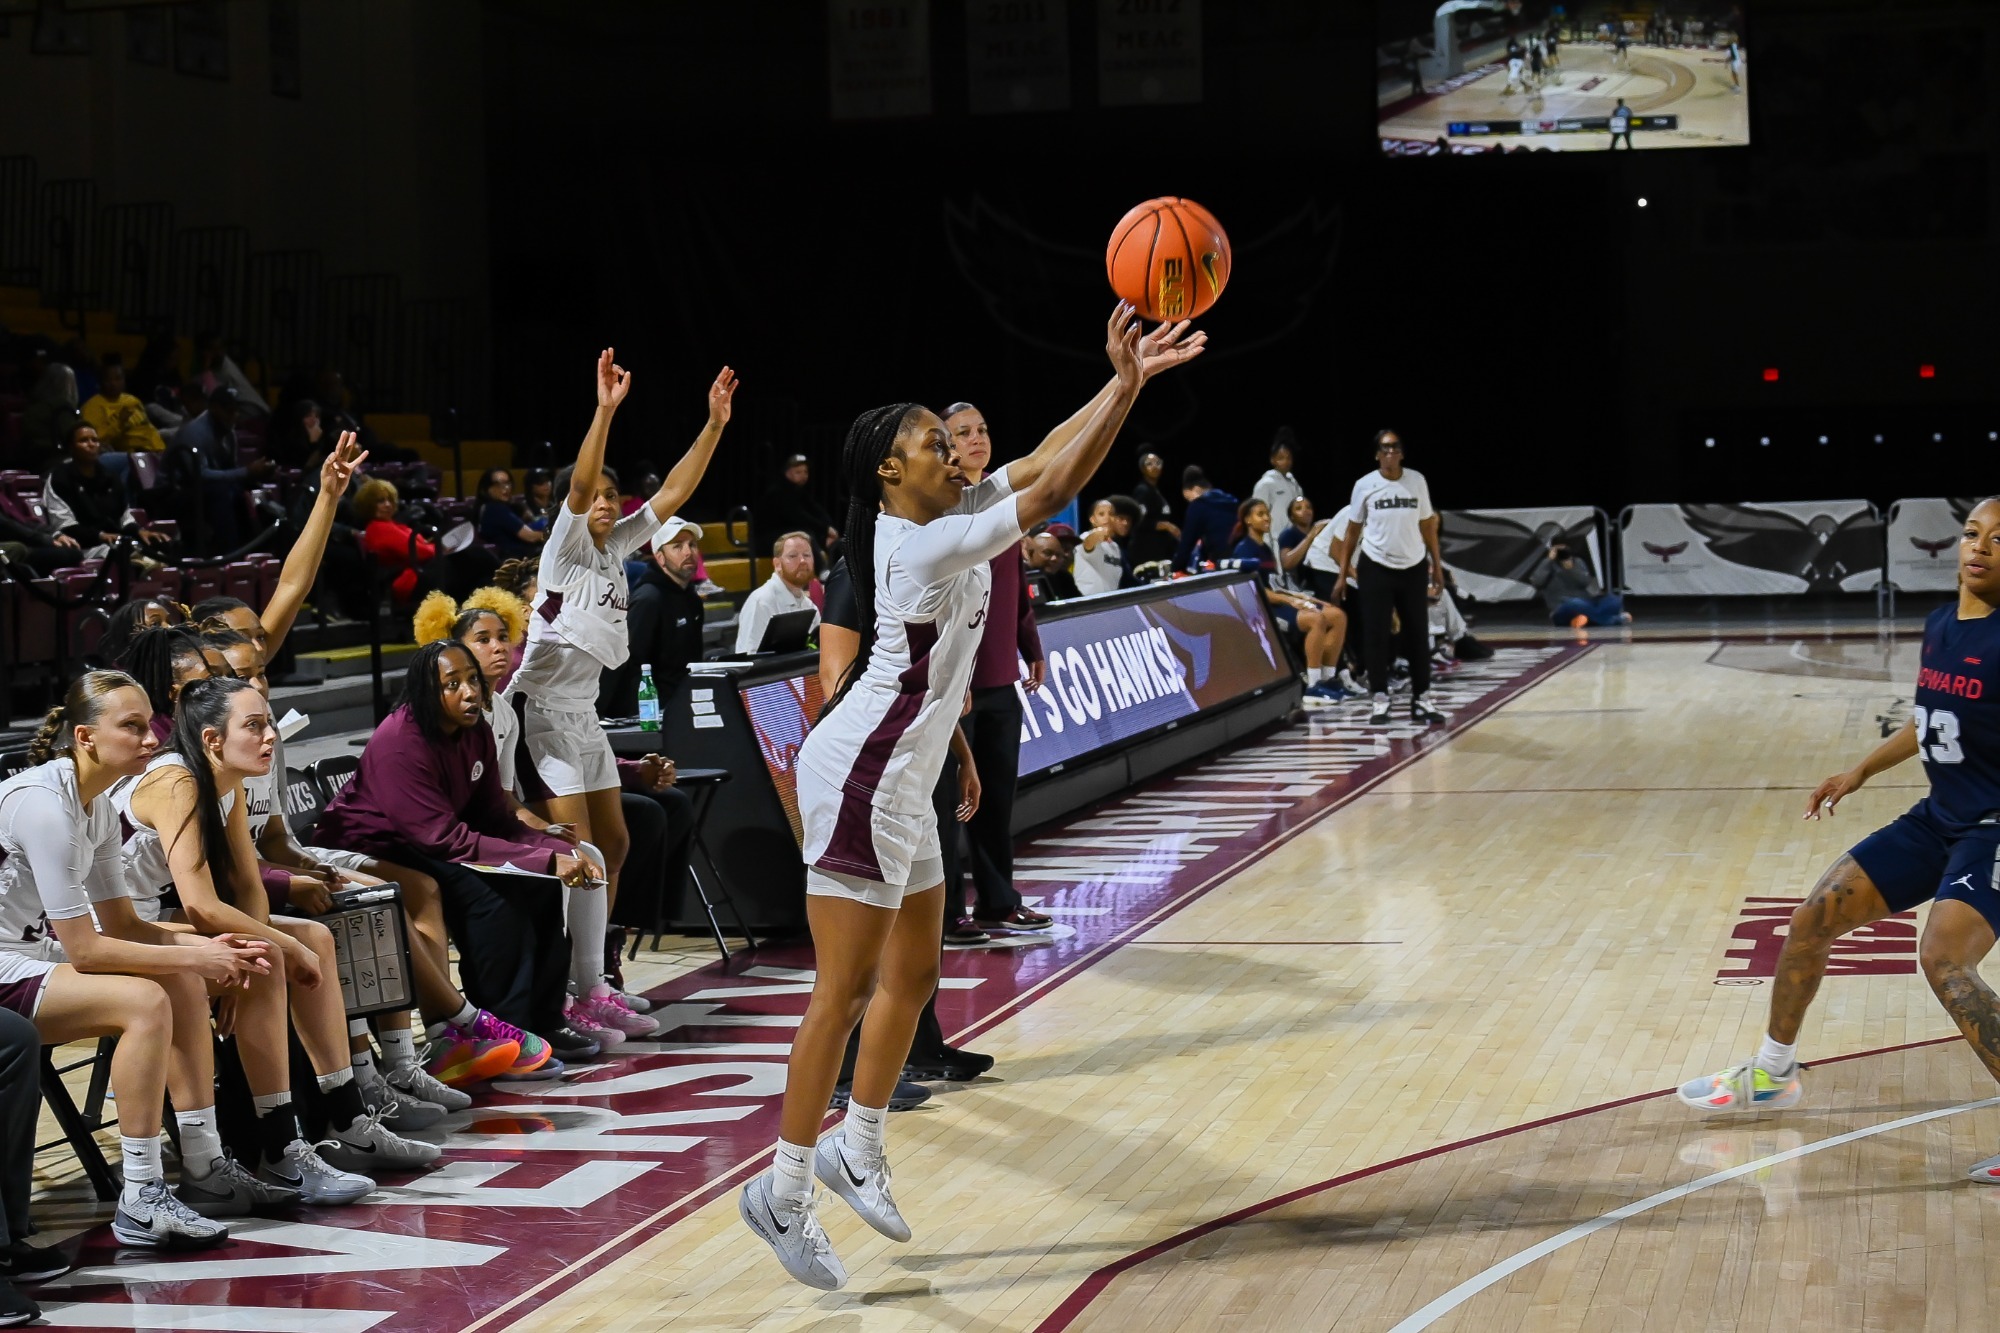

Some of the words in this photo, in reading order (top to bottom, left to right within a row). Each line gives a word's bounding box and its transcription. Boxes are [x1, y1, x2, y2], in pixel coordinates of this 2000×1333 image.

[1049, 646, 1102, 726] GO
[1085, 626, 1187, 713] HAWKS!
[1918, 666, 1983, 699] OWARD
[286, 781, 317, 816] WKS
[349, 915, 364, 938] Bri
[361, 970, 375, 989] 23
[380, 967, 398, 980] 4
